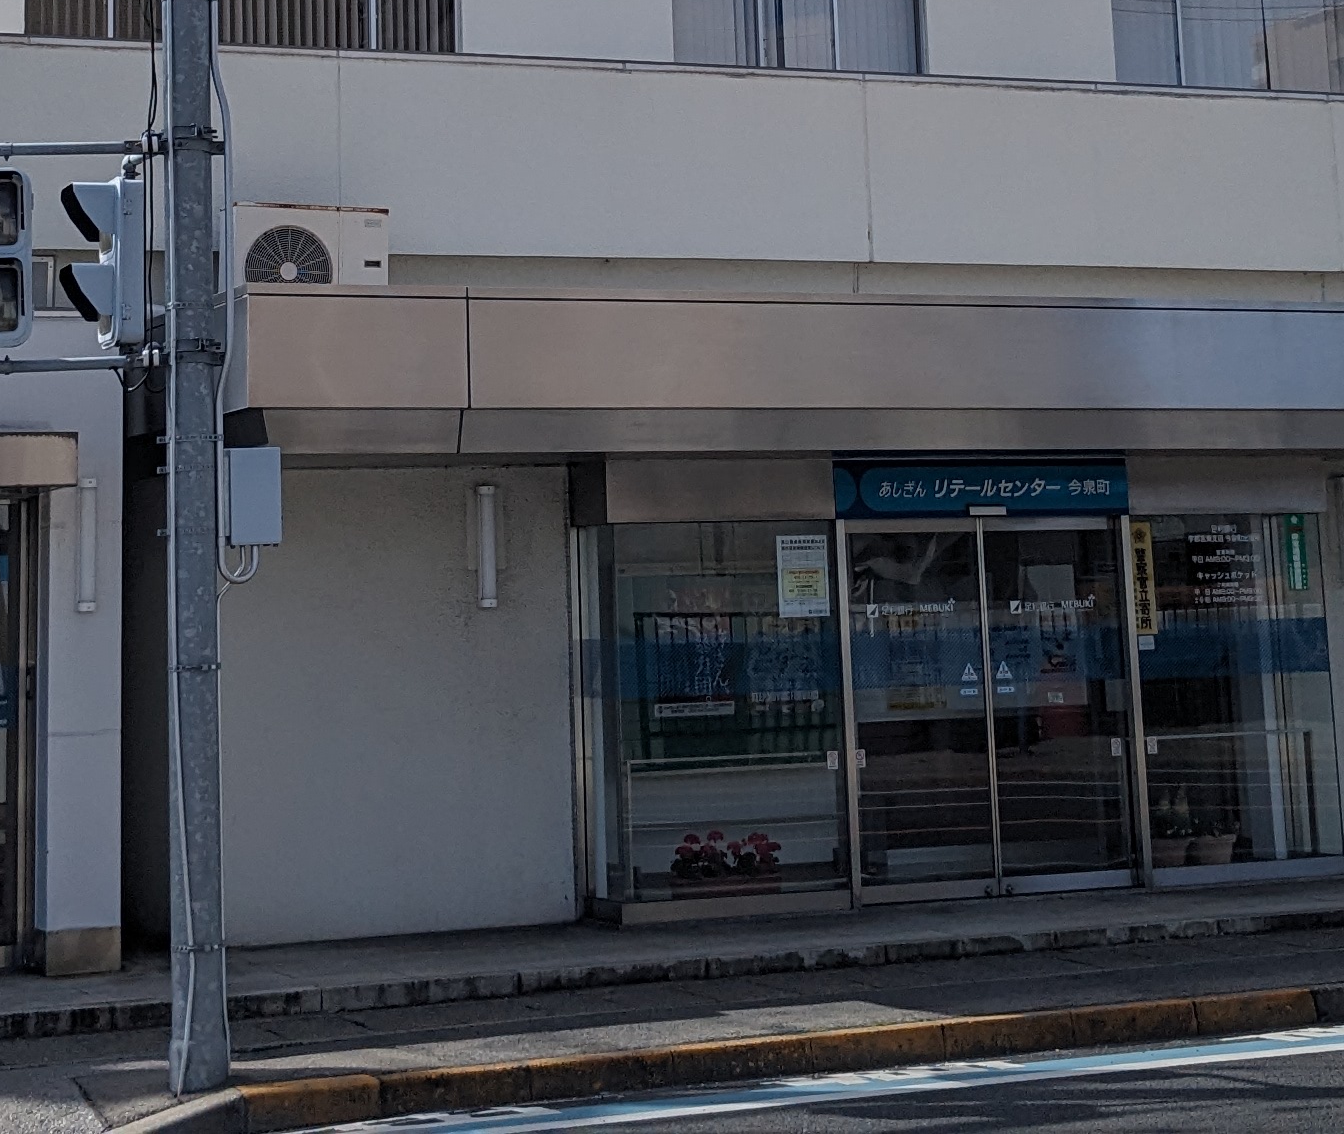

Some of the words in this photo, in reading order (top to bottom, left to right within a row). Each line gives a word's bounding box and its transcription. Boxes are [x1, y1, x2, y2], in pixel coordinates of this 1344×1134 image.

[878, 480, 927, 498] あしぎん
[933, 478, 1061, 498] リテールセンター
[1067, 478, 1110, 496] 今泉町
[1134, 547, 1152, 630] 警察官立寄所
[919, 603, 954, 613] MEBUKI
[1061, 598, 1094, 609] MEBUKI
